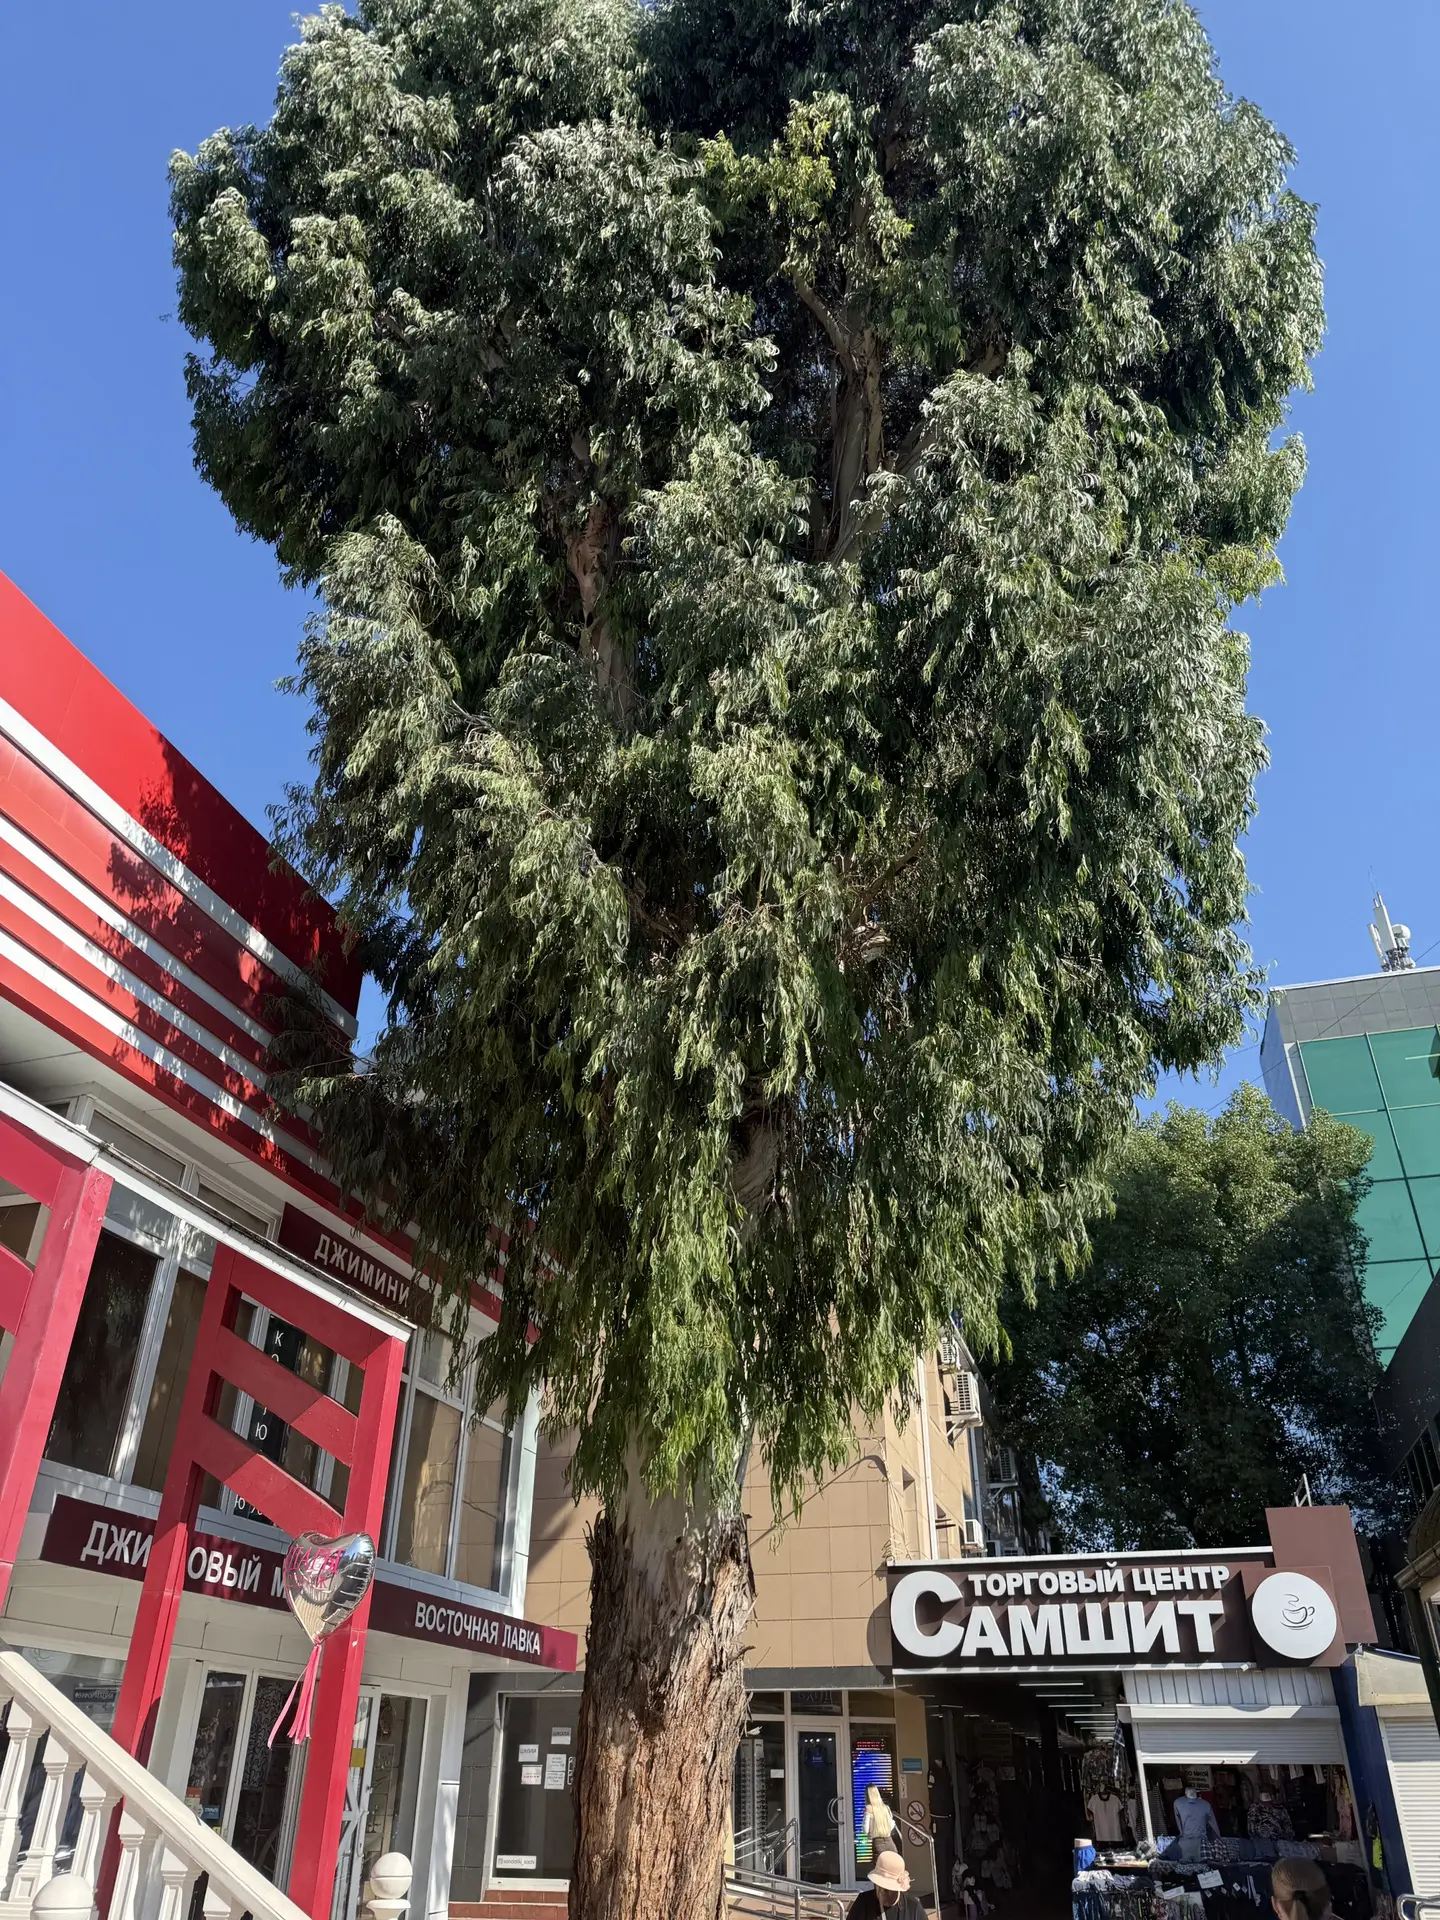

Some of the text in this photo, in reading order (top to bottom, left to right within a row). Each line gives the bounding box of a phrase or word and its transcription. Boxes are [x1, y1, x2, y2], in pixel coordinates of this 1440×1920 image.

[313, 1233, 410, 1308] ДЖИМИНИ
[968, 1561, 1230, 1597] ТОРГОВЫЙ ЦЕНТР
[414, 1602, 541, 1656] ВОСТОЧНАЯ ЛАВКА
[890, 1570, 1224, 1658] САМШИТ
